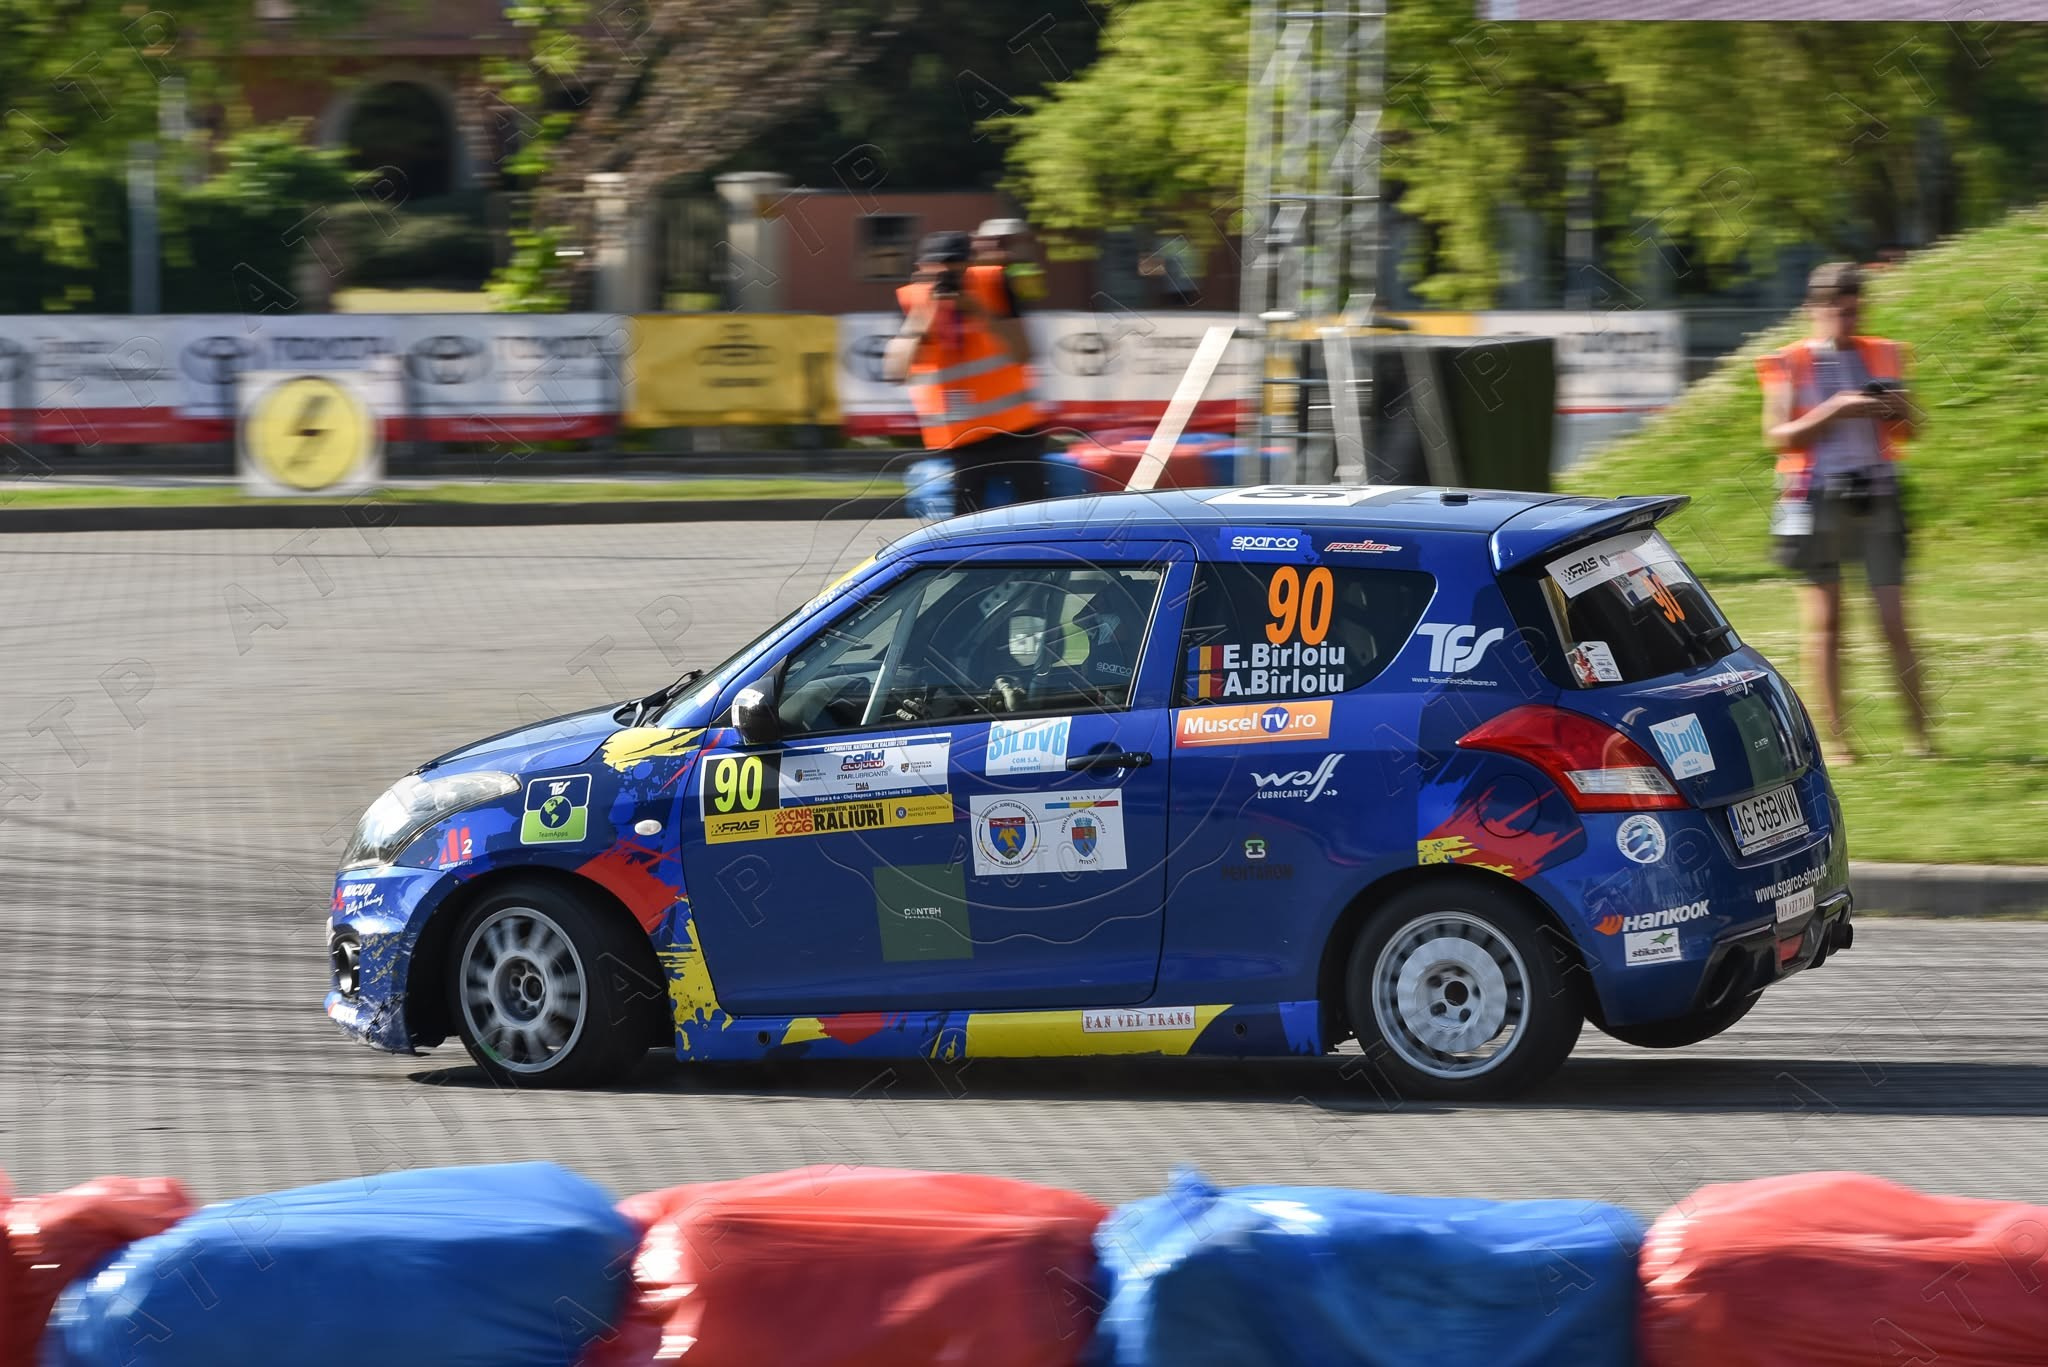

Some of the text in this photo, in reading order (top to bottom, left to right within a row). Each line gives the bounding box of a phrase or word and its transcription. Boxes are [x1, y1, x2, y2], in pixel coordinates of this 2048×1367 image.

[1231, 535, 1298, 551] sparco
[1568, 557, 1599, 578] FRAS
[1265, 565, 1334, 646] 90
[1223, 641, 1345, 669] E.Bîrloiu
[1416, 622, 1504, 673] TFS
[1096, 661, 1133, 677] sparco
[1223, 668, 1344, 697] A.Bîrloiu
[713, 755, 763, 813] 90
[1257, 789, 1308, 799] LUBRICANTS
[720, 820, 760, 832] FRAS
[775, 819, 814, 836] 2026
[815, 809, 885, 832] RALIURI
[1735, 804, 1755, 840] AG
[1755, 863, 1827, 904] www.sparco-shop.ro
[1632, 946, 1674, 957] stikarom
[1117, 1013, 1143, 1028] VEL
[1147, 1011, 1192, 1026] TRANS
